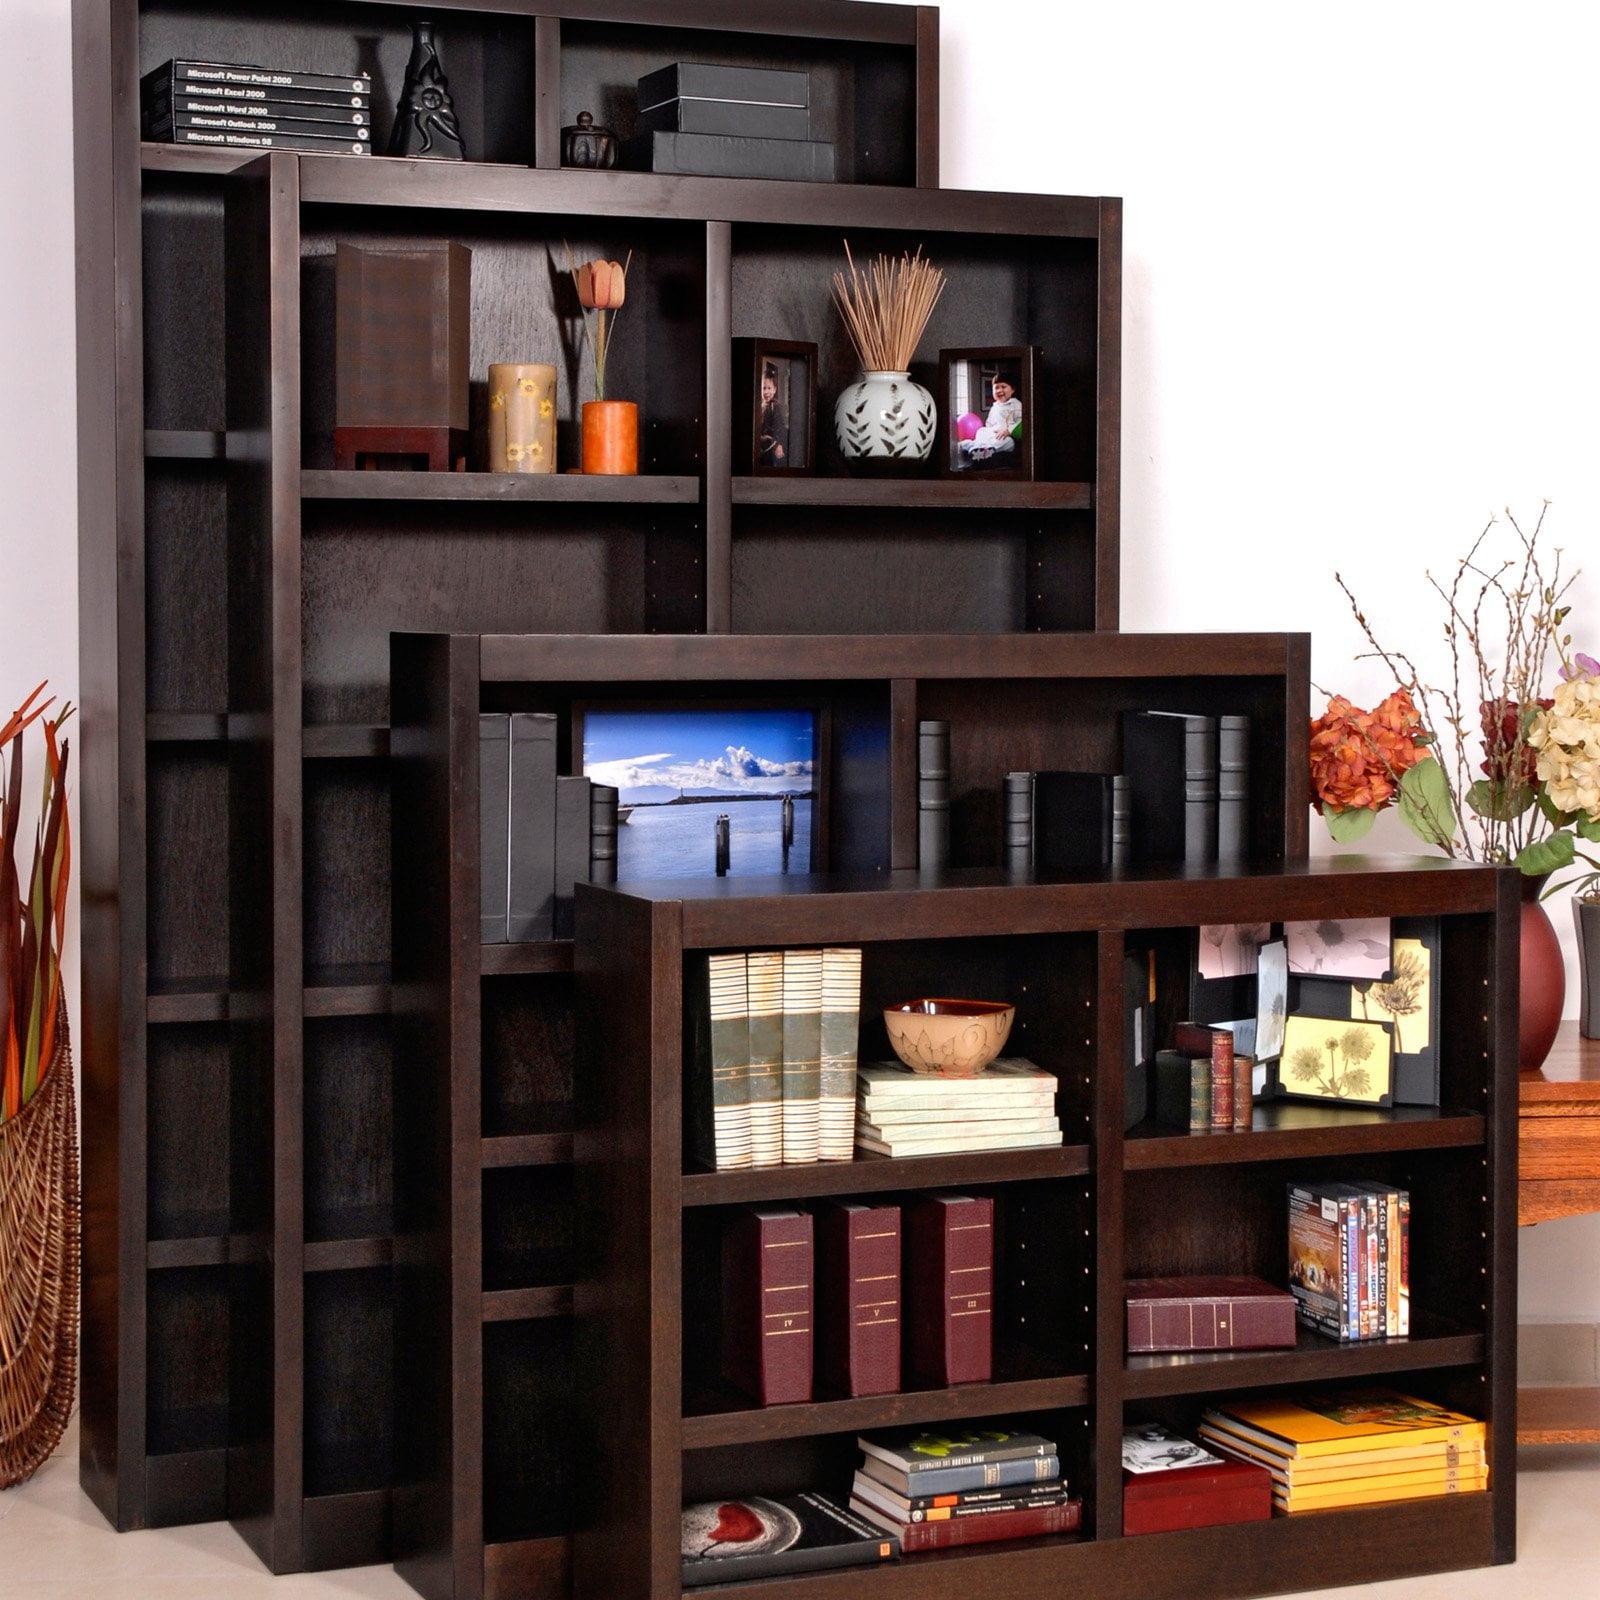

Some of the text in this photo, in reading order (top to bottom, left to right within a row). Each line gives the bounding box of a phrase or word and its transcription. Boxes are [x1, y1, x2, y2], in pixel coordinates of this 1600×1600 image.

[187, 69, 292, 84] Microsoft Power Point 2000
[185, 85, 265, 98] Microsoft Excel 2000
[187, 103, 268, 115] Microsoft Word 2000
[191, 117, 276, 131] Microsoft Outlook 2000
[187, 133, 272, 146] Microsoft Windows 98
[1380, 1238, 1386, 1253] IN
[968, 1300, 976, 1308] III
[874, 1309, 880, 1317] V
[784, 1319, 793, 1327] IV
